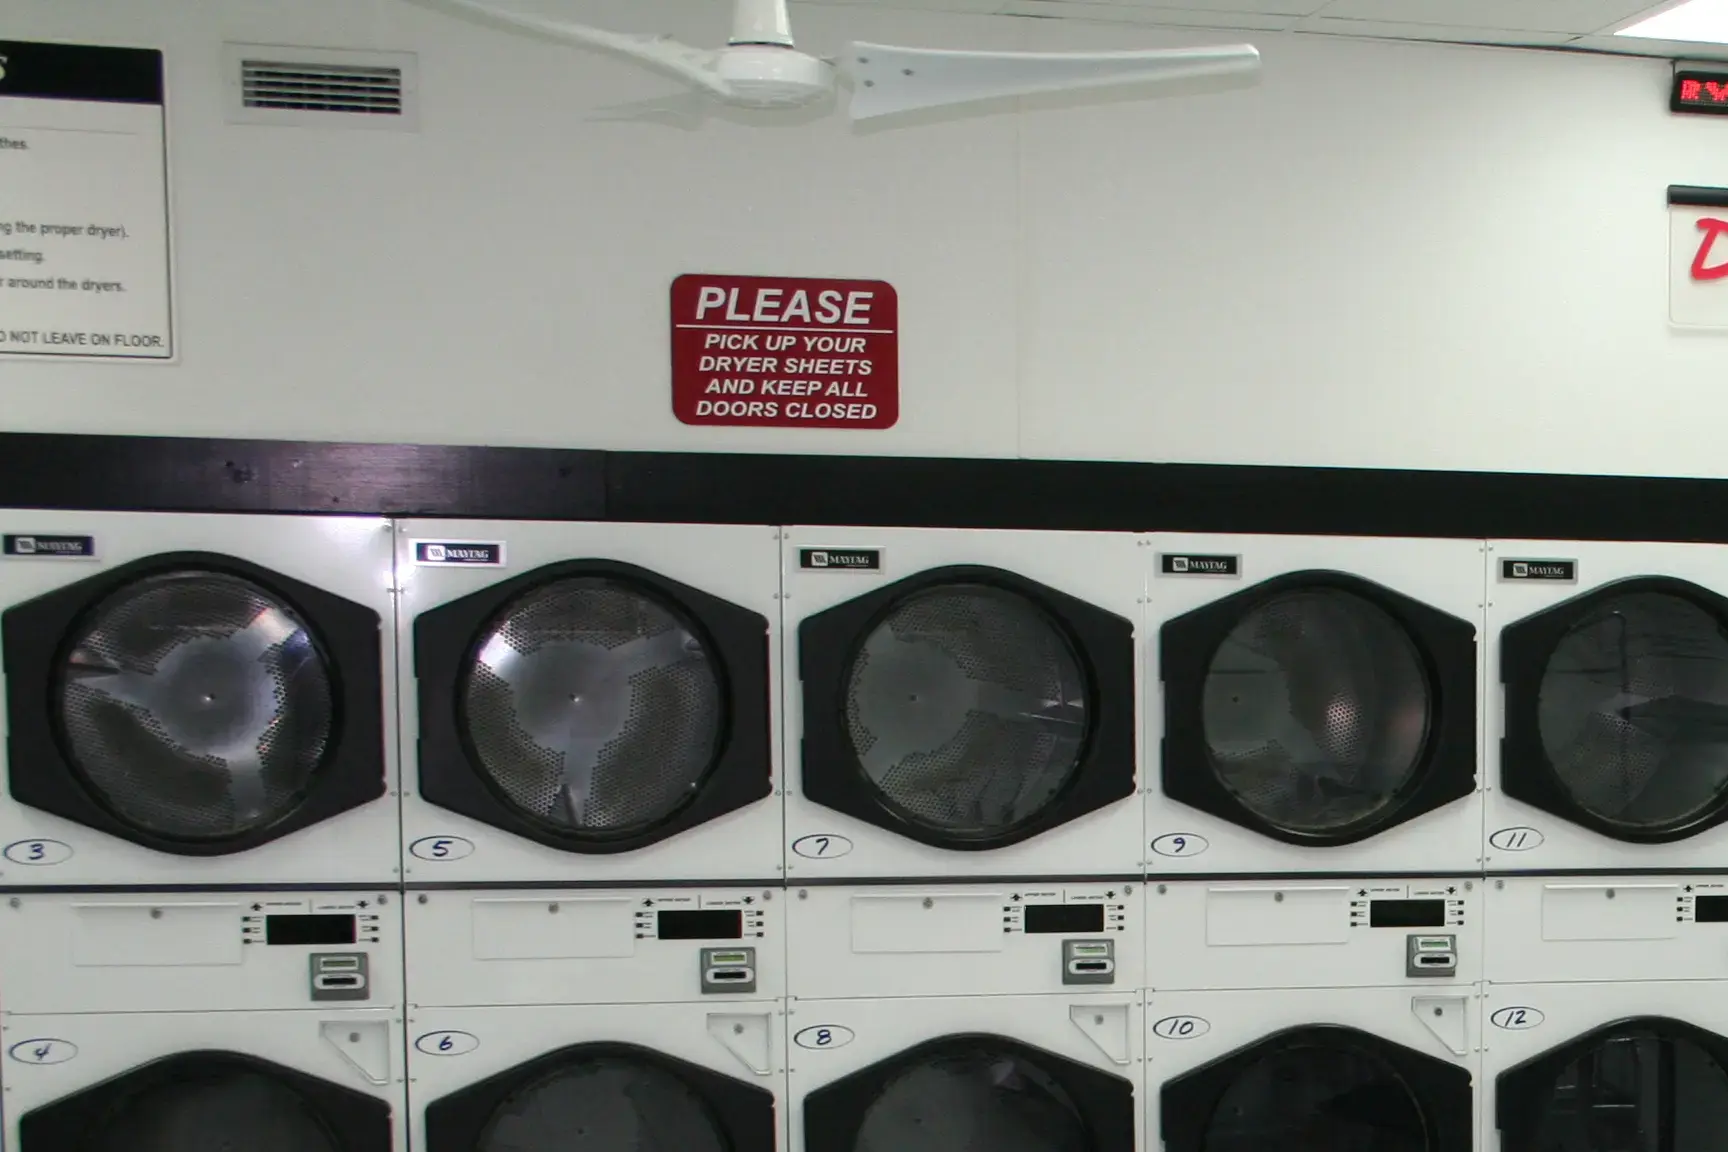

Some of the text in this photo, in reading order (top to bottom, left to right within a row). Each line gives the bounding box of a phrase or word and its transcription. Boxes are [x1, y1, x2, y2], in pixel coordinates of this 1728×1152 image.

[15, 221, 37, 233] the
[41, 223, 82, 239] proper
[8, 277, 53, 289] around
[57, 278, 78, 290] the
[81, 279, 126, 294] dryers.
[696, 286, 874, 324] PLEASE
[9, 331, 38, 343] NOT
[43, 332, 87, 345] LEAVE
[91, 333, 110, 346] ON
[114, 334, 164, 348] FLOOR.
[704, 333, 867, 353] PICK UP YOUR
[699, 356, 873, 375] DRYER SHEETS
[705, 379, 868, 397] AND KEEP ALL
[696, 401, 877, 420] DOORS CLOSED
[447, 550, 488, 558] MAYTAG
[830, 555, 869, 564] MAYTAG
[1190, 560, 1227, 569] MAYTAG
[1530, 566, 1564, 574] MAYTAG
[816, 837, 829, 855] 7
[1173, 837, 1185, 852] 9
[1507, 832, 1527, 847] 11
[29, 844, 44, 860] 3
[432, 841, 453, 857] 5
[1505, 1010, 1526, 1026] 12
[1168, 1018, 1193, 1035] 10
[439, 1036, 453, 1051] 6
[816, 1029, 832, 1045] 8
[35, 1043, 52, 1060] 4
